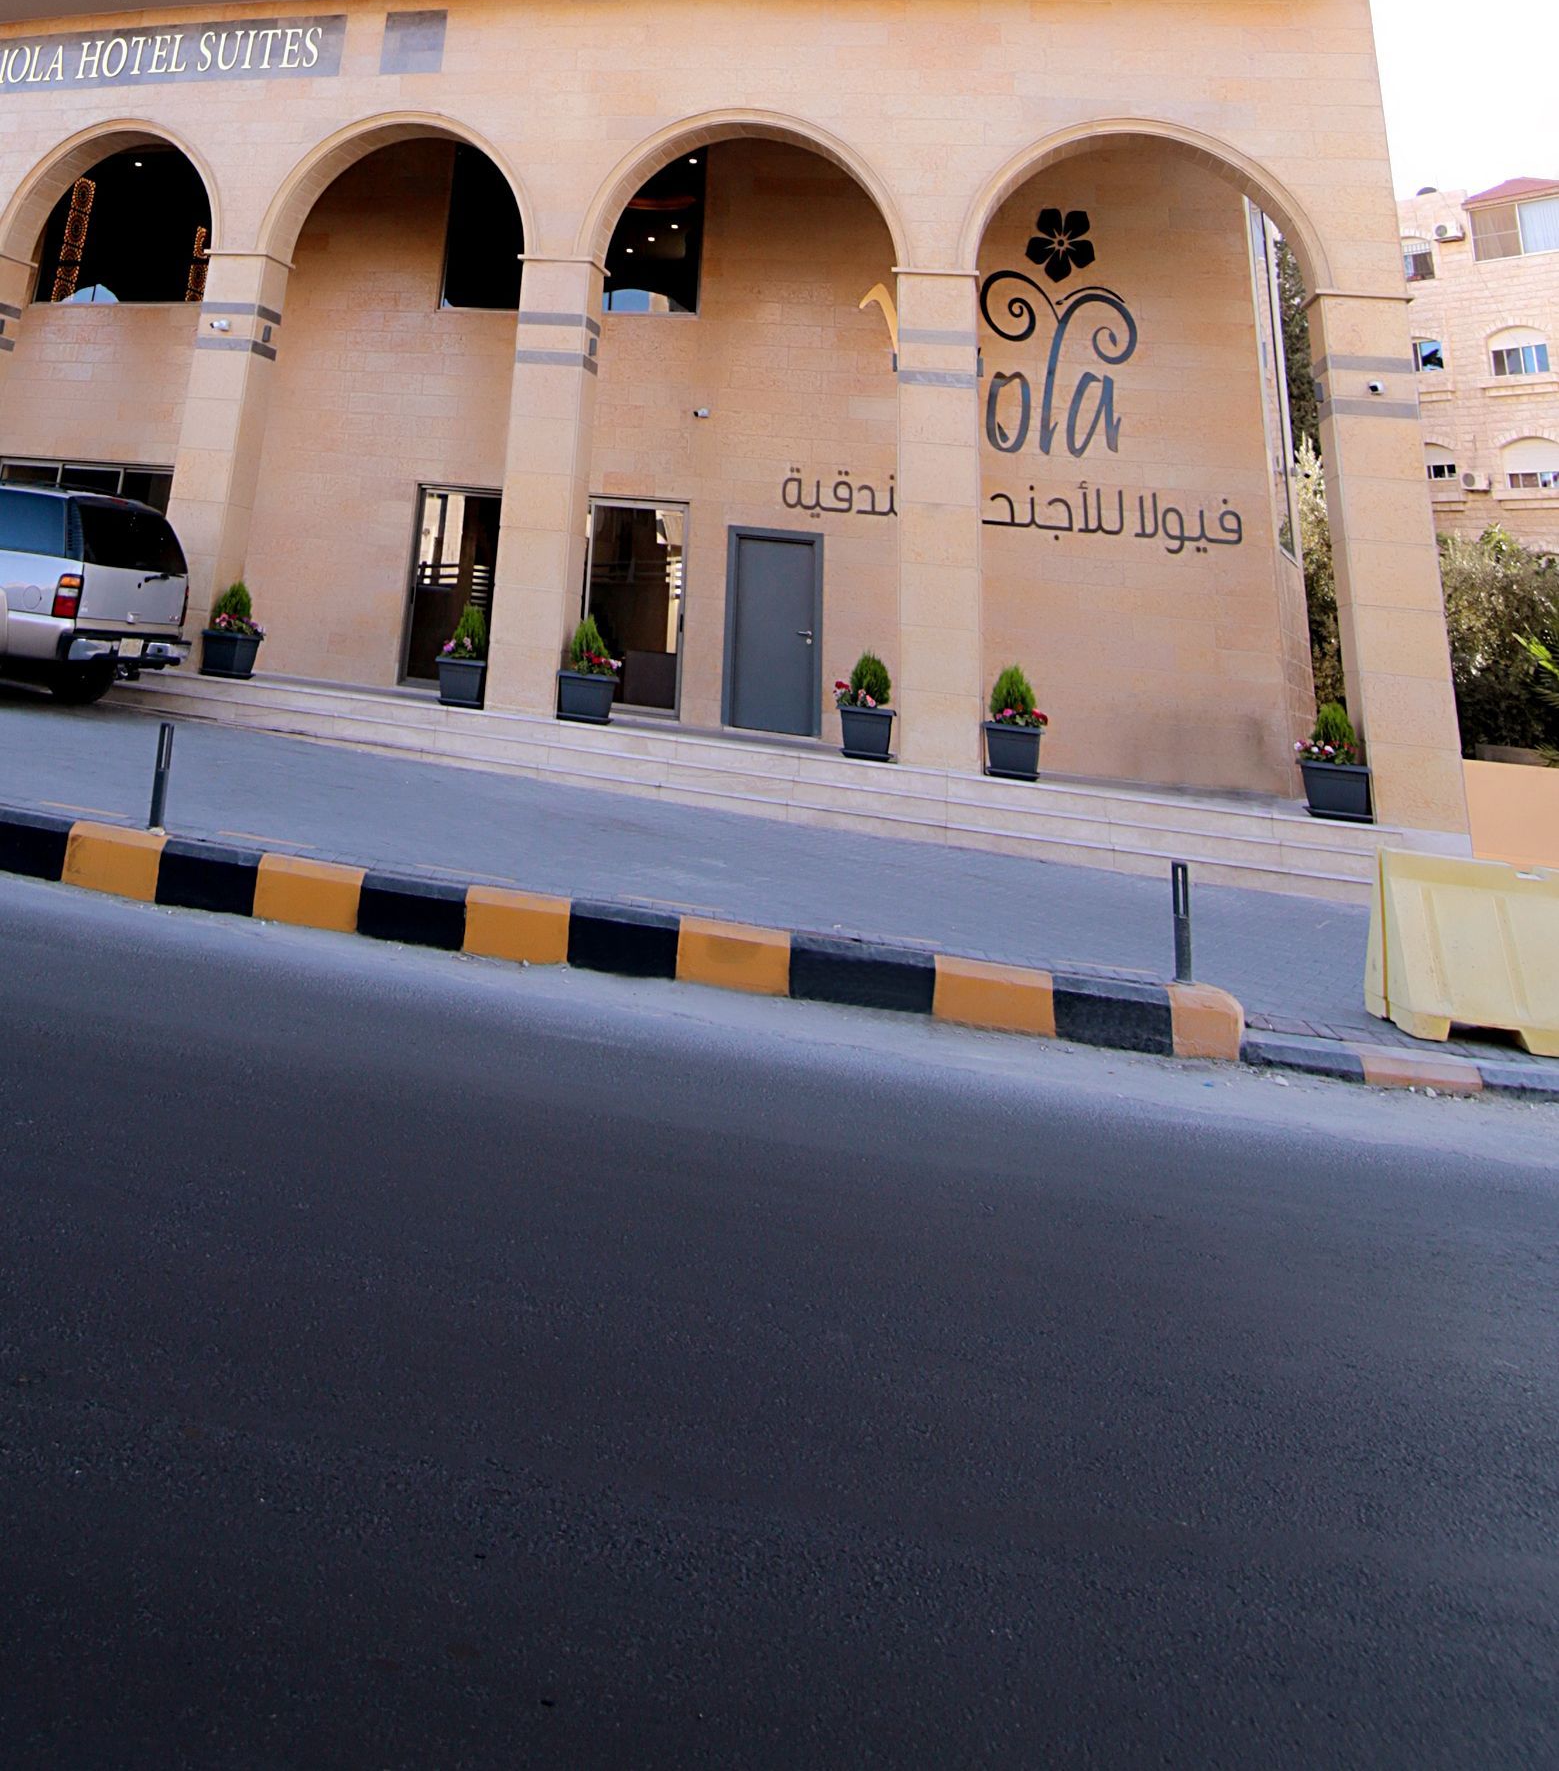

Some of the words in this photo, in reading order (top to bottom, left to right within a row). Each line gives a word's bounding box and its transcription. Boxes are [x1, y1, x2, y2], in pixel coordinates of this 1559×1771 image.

[0, 44, 64, 85] IOLA
[75, 34, 188, 80] HOTEL
[197, 27, 323, 72] SUITES
[1134, 491, 1243, 554] فيولا
